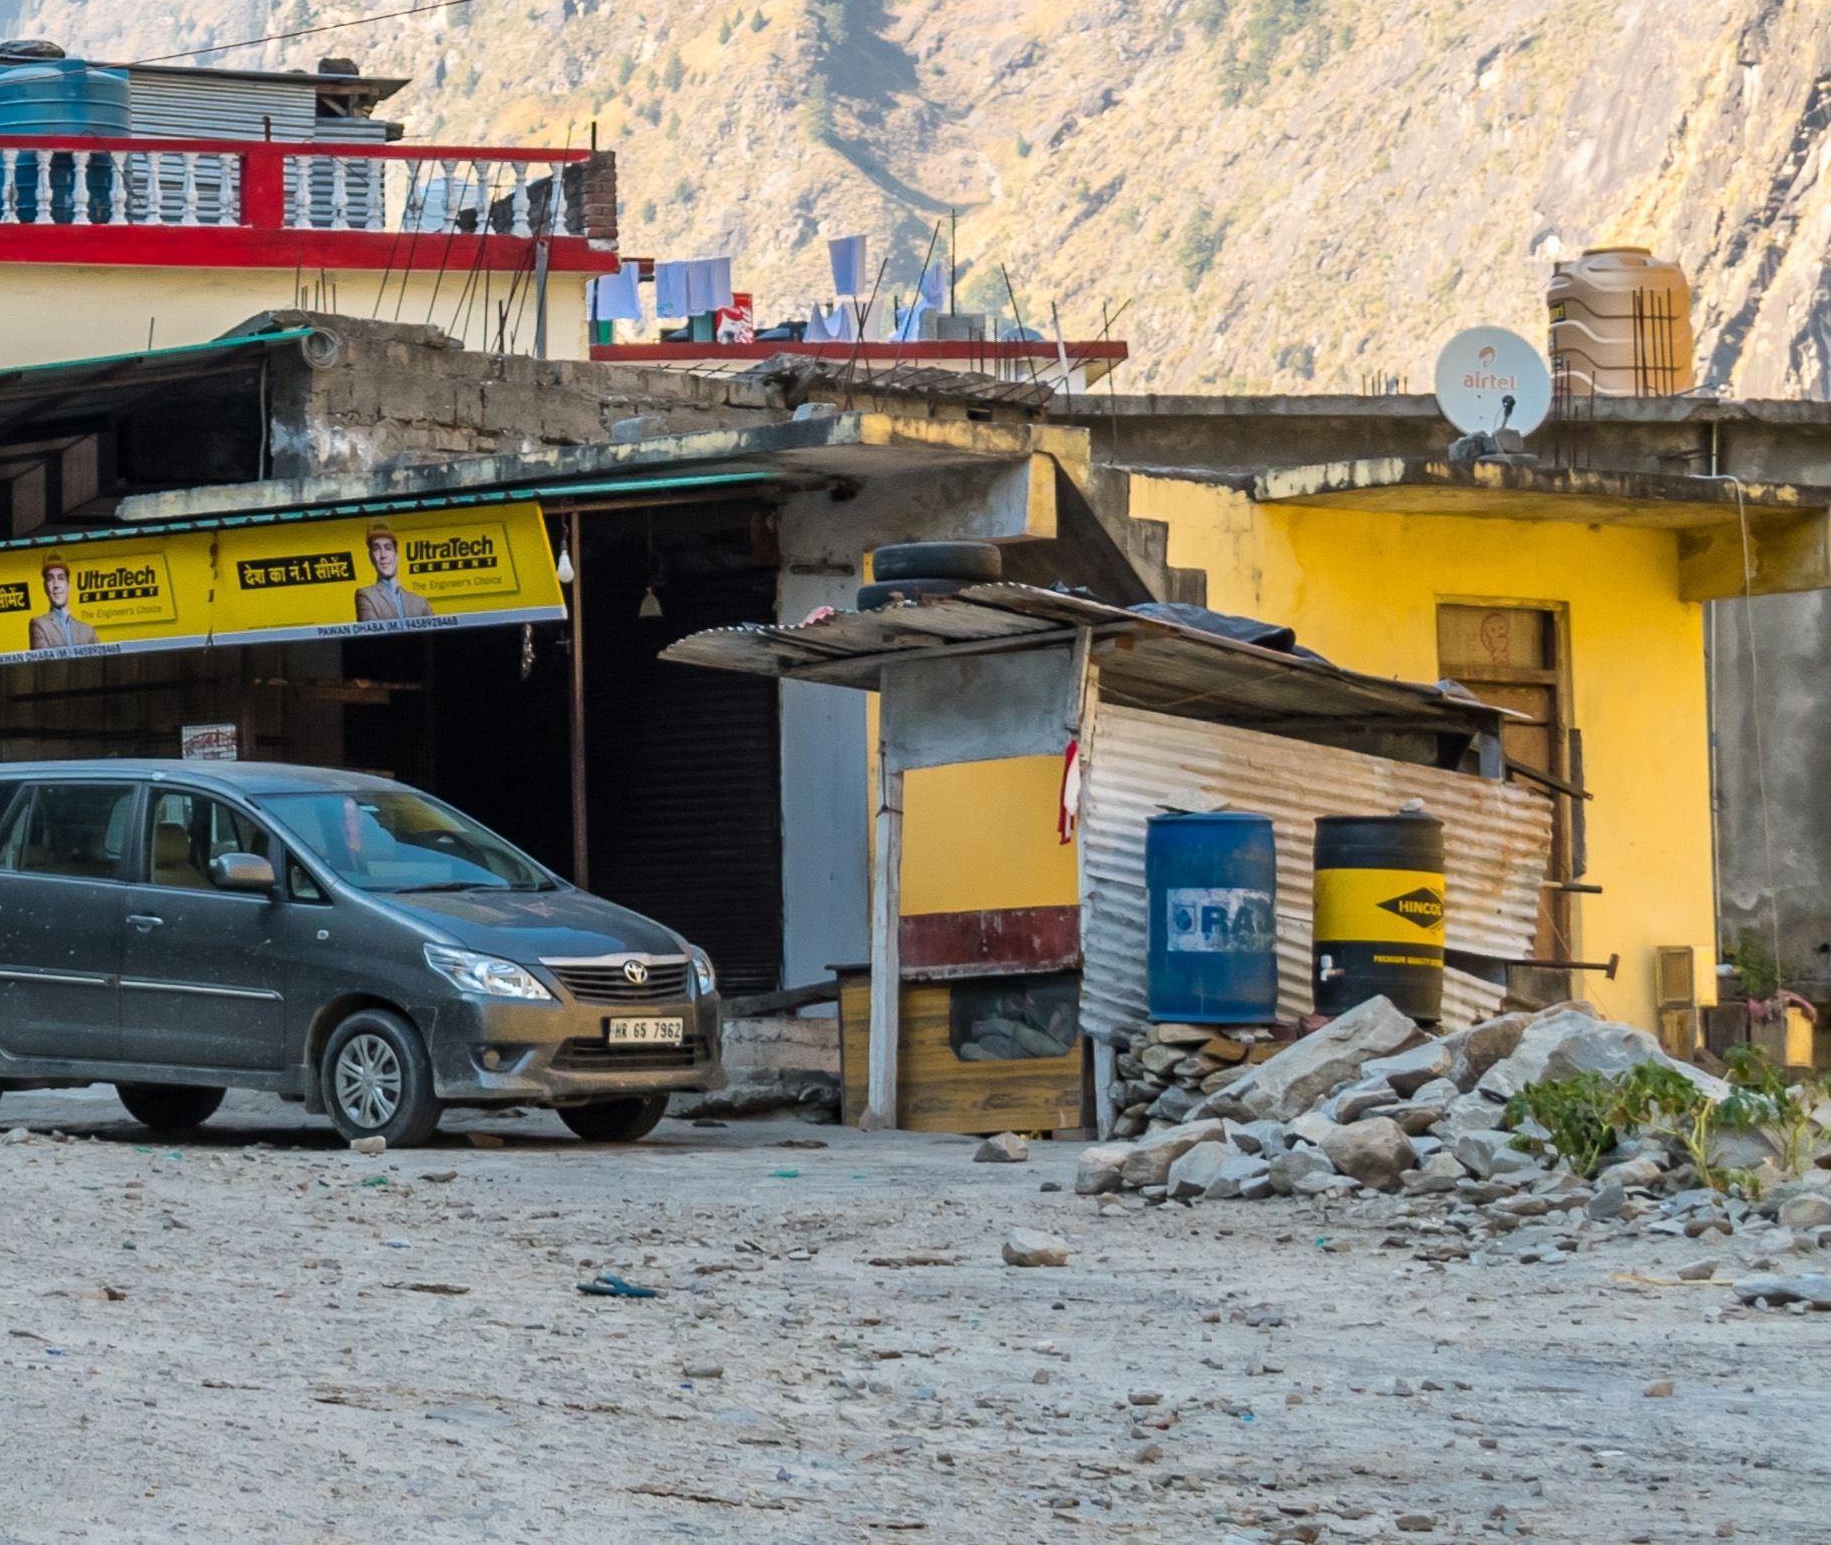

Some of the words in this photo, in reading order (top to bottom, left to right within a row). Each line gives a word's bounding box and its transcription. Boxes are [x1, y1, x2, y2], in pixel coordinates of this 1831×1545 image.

[1463, 371, 1516, 391] airtel
[406, 535, 493, 561] UltraTech
[244, 564, 266, 585] देश
[268, 567, 286, 583] का
[314, 556, 350, 579] सीमेंट
[413, 558, 492, 573] CEMENT
[77, 565, 156, 591] UltraTech
[318, 625, 351, 637] PAWAN
[353, 623, 384, 635] DHABA
[633, 1022, 648, 1039] 65
[653, 1022, 681, 1039] 7962
